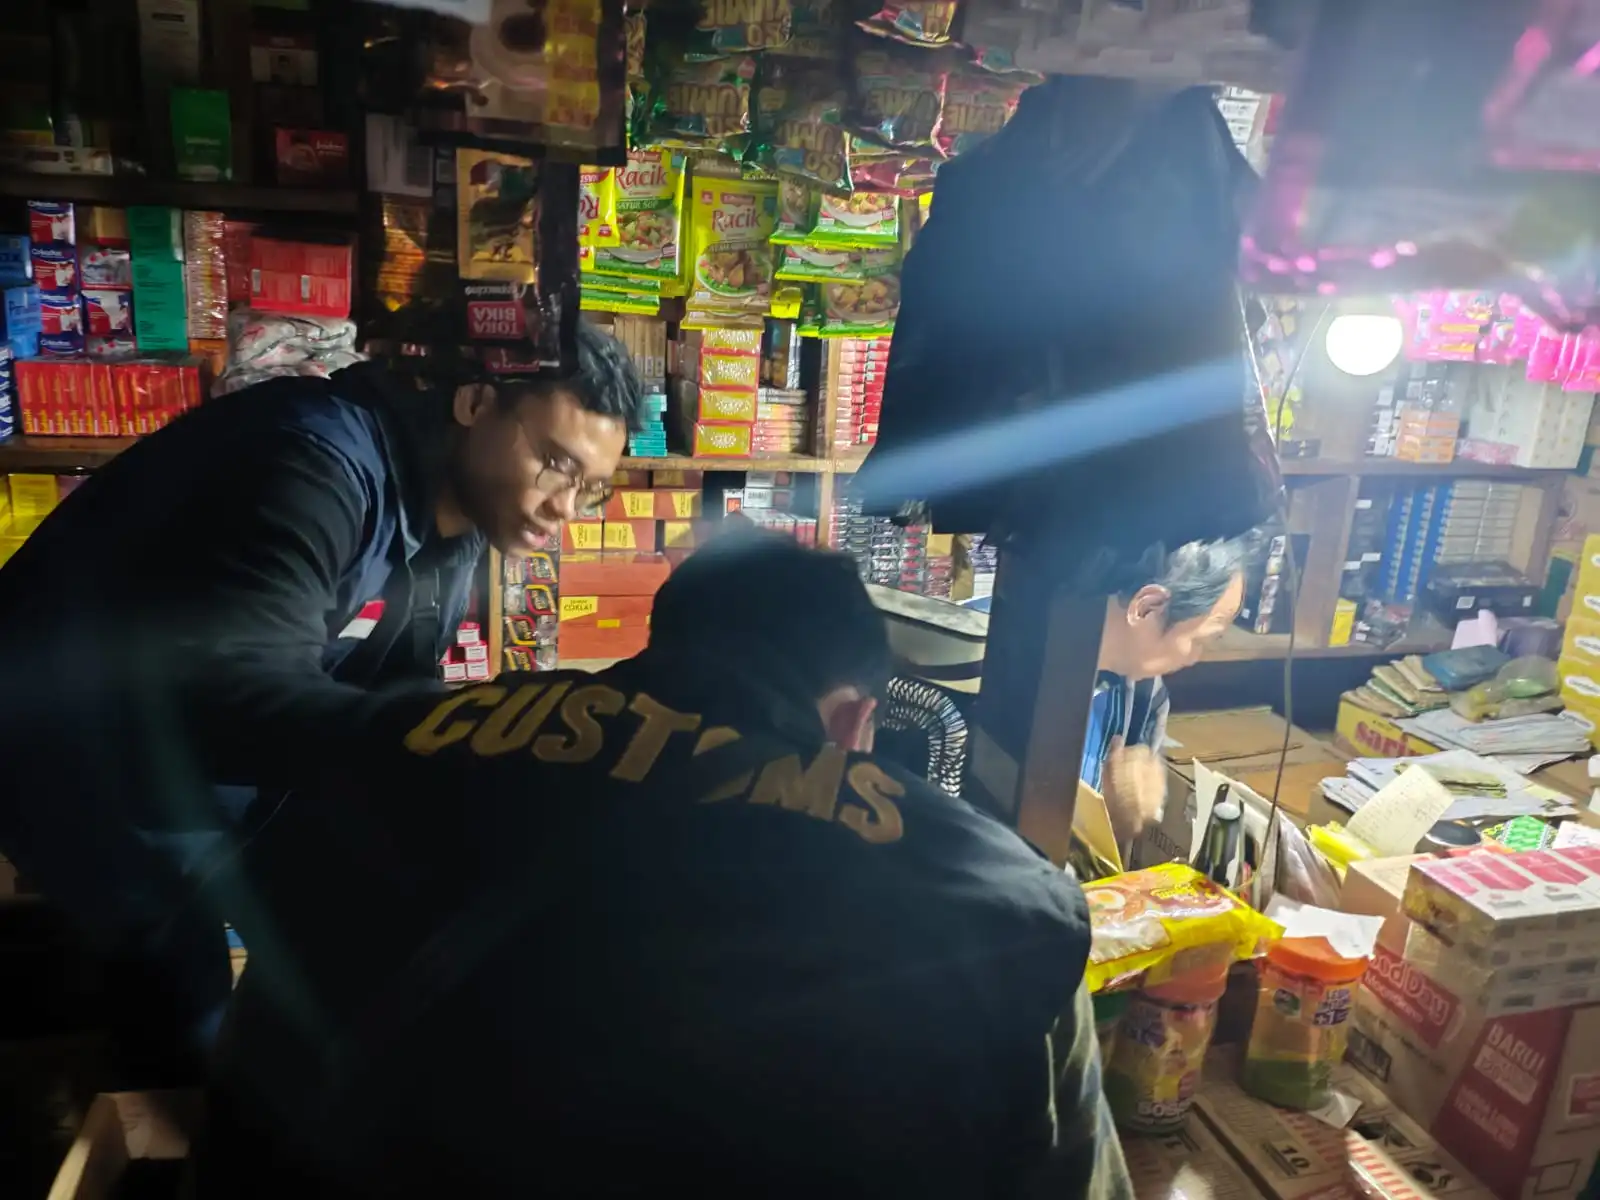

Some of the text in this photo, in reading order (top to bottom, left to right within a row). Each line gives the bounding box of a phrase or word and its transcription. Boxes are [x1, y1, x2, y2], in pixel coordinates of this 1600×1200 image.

[614, 165, 668, 190] Racik
[712, 208, 761, 233] Racik
[472, 306, 517, 321] BIKA
